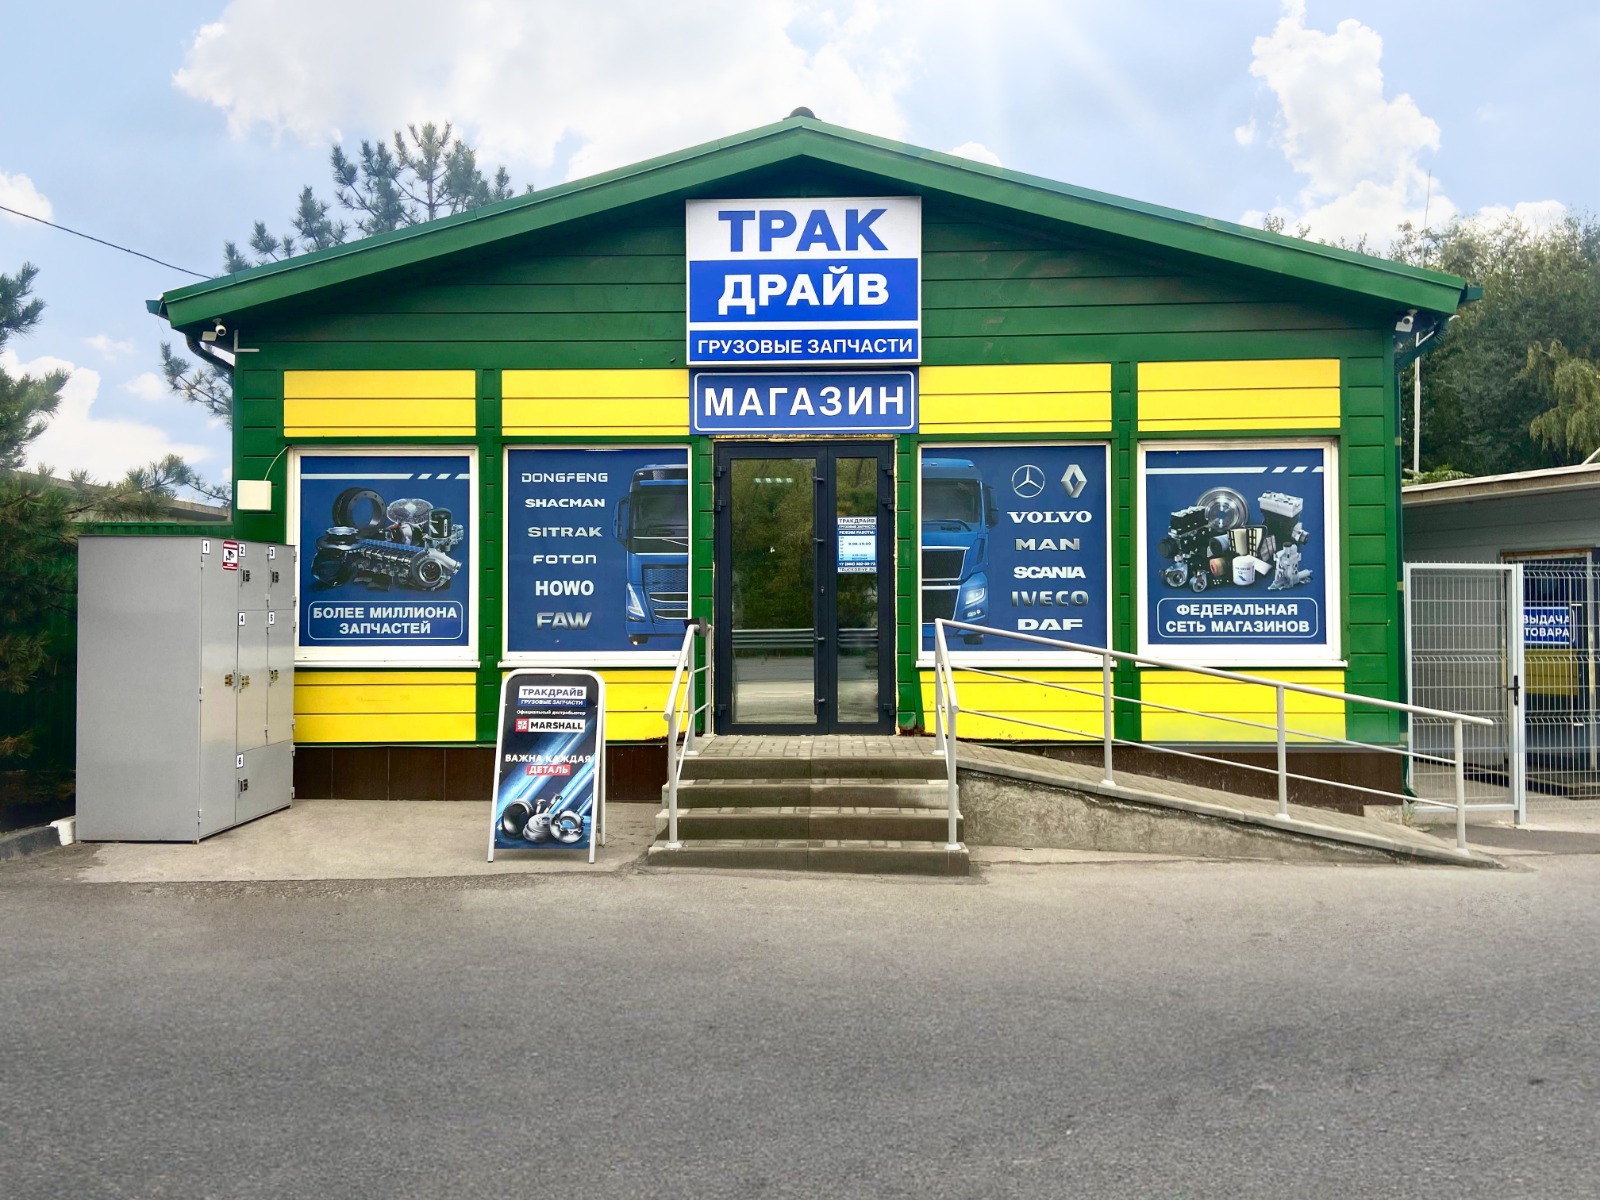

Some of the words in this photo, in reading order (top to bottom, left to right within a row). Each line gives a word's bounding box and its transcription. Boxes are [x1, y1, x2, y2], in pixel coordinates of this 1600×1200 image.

[718, 208, 889, 252] ТРАК
[717, 265, 889, 316] ДРАЙВ
[698, 339, 802, 354] ГРУЗОВЫЕ
[807, 338, 913, 353] ЗАПЧАСТИ
[704, 386, 904, 416] МАГАЗИН
[521, 472, 608, 483] DONGFENG
[524, 498, 606, 508] SHACMAN
[1006, 510, 1093, 524] VOLVO
[527, 526, 603, 538] SITRAK
[1015, 538, 1080, 551] MAN
[532, 554, 597, 565] FOTON
[1013, 566, 1087, 579] SCANIA
[535, 580, 595, 596] HOWO
[1011, 590, 1089, 607] IVECO
[313, 607, 365, 619] БОЛЕЕ
[369, 607, 458, 619] МИЛЛИОНА
[1176, 603, 1298, 618] ФЕДЕРАЛЬНАЯ
[339, 620, 431, 634] ЗАПЧАСТЕЙ
[536, 612, 593, 630] FAW
[1017, 618, 1083, 631] DAF
[1165, 620, 1206, 633] СЕТЬ
[1211, 620, 1310, 633] МАГАЗИНОВ
[1524, 627, 1569, 637] ТОВАРА
[522, 688, 584, 697] ТРАКДРАЙВ
[530, 721, 583, 730] MARSHALL
[505, 754, 542, 763] ВАЖНА
[545, 754, 591, 764] КАЖДАЯ
[528, 765, 568, 774] ДЕТАЛЬ
